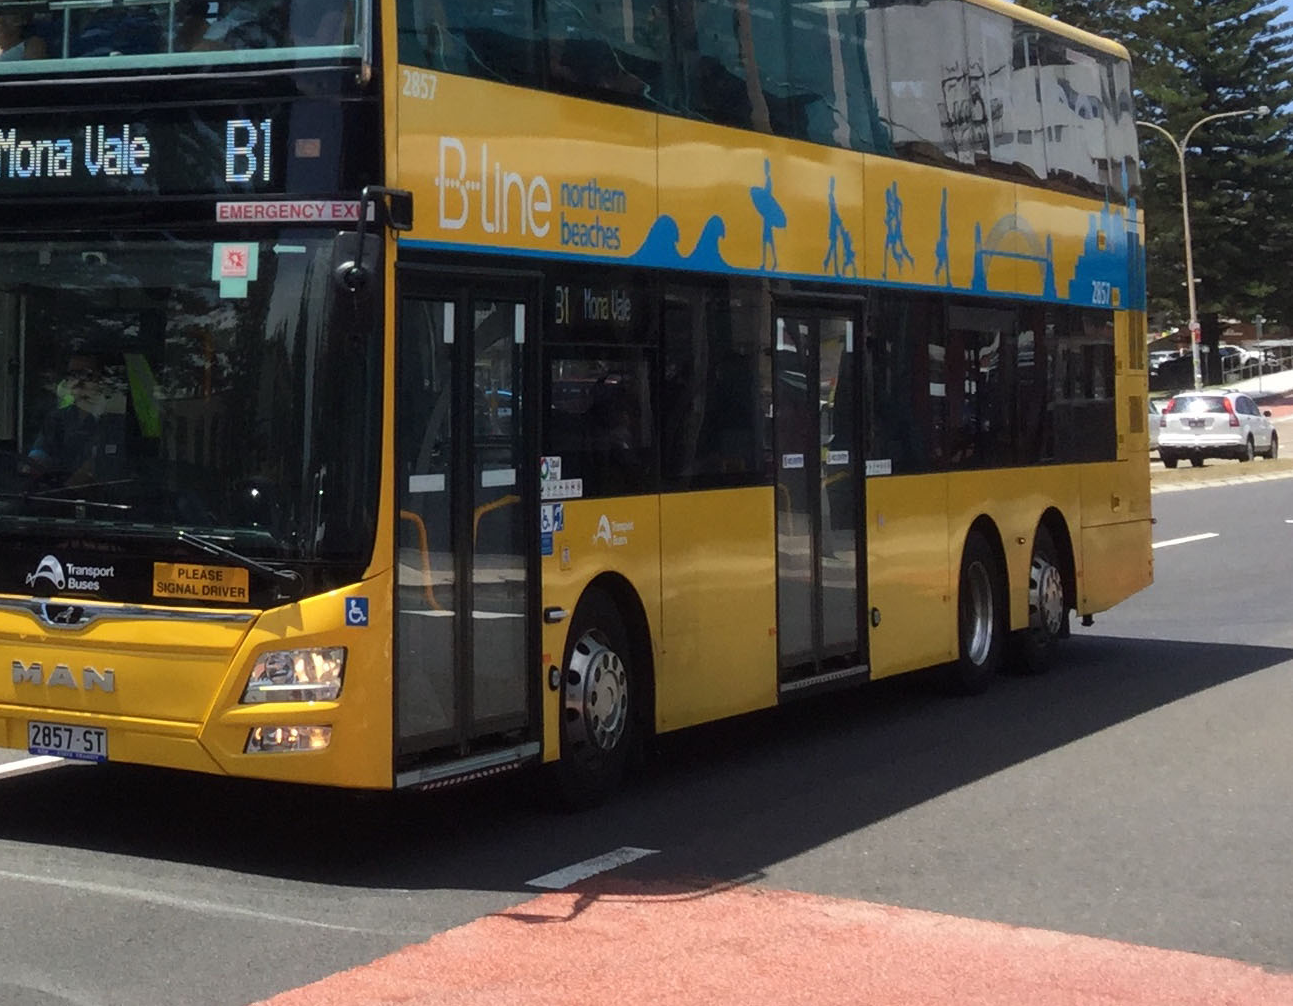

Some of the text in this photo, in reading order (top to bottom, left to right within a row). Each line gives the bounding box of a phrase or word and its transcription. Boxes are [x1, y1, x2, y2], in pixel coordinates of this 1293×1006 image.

[402, 70, 436, 99] 2857
[84, 124, 150, 175] Vale
[225, 118, 272, 182] B1
[560, 177, 627, 214] northern
[219, 204, 371, 219] EMERGENCY EXI
[560, 211, 622, 250] beaches
[1091, 280, 1111, 305] 2857
[66, 563, 115, 578] Transport
[67, 577, 100, 591] Buses
[177, 568, 223, 582] PLEASE
[156, 581, 246, 599] SIGNAL DRIVER
[11, 659, 115, 693] MAN
